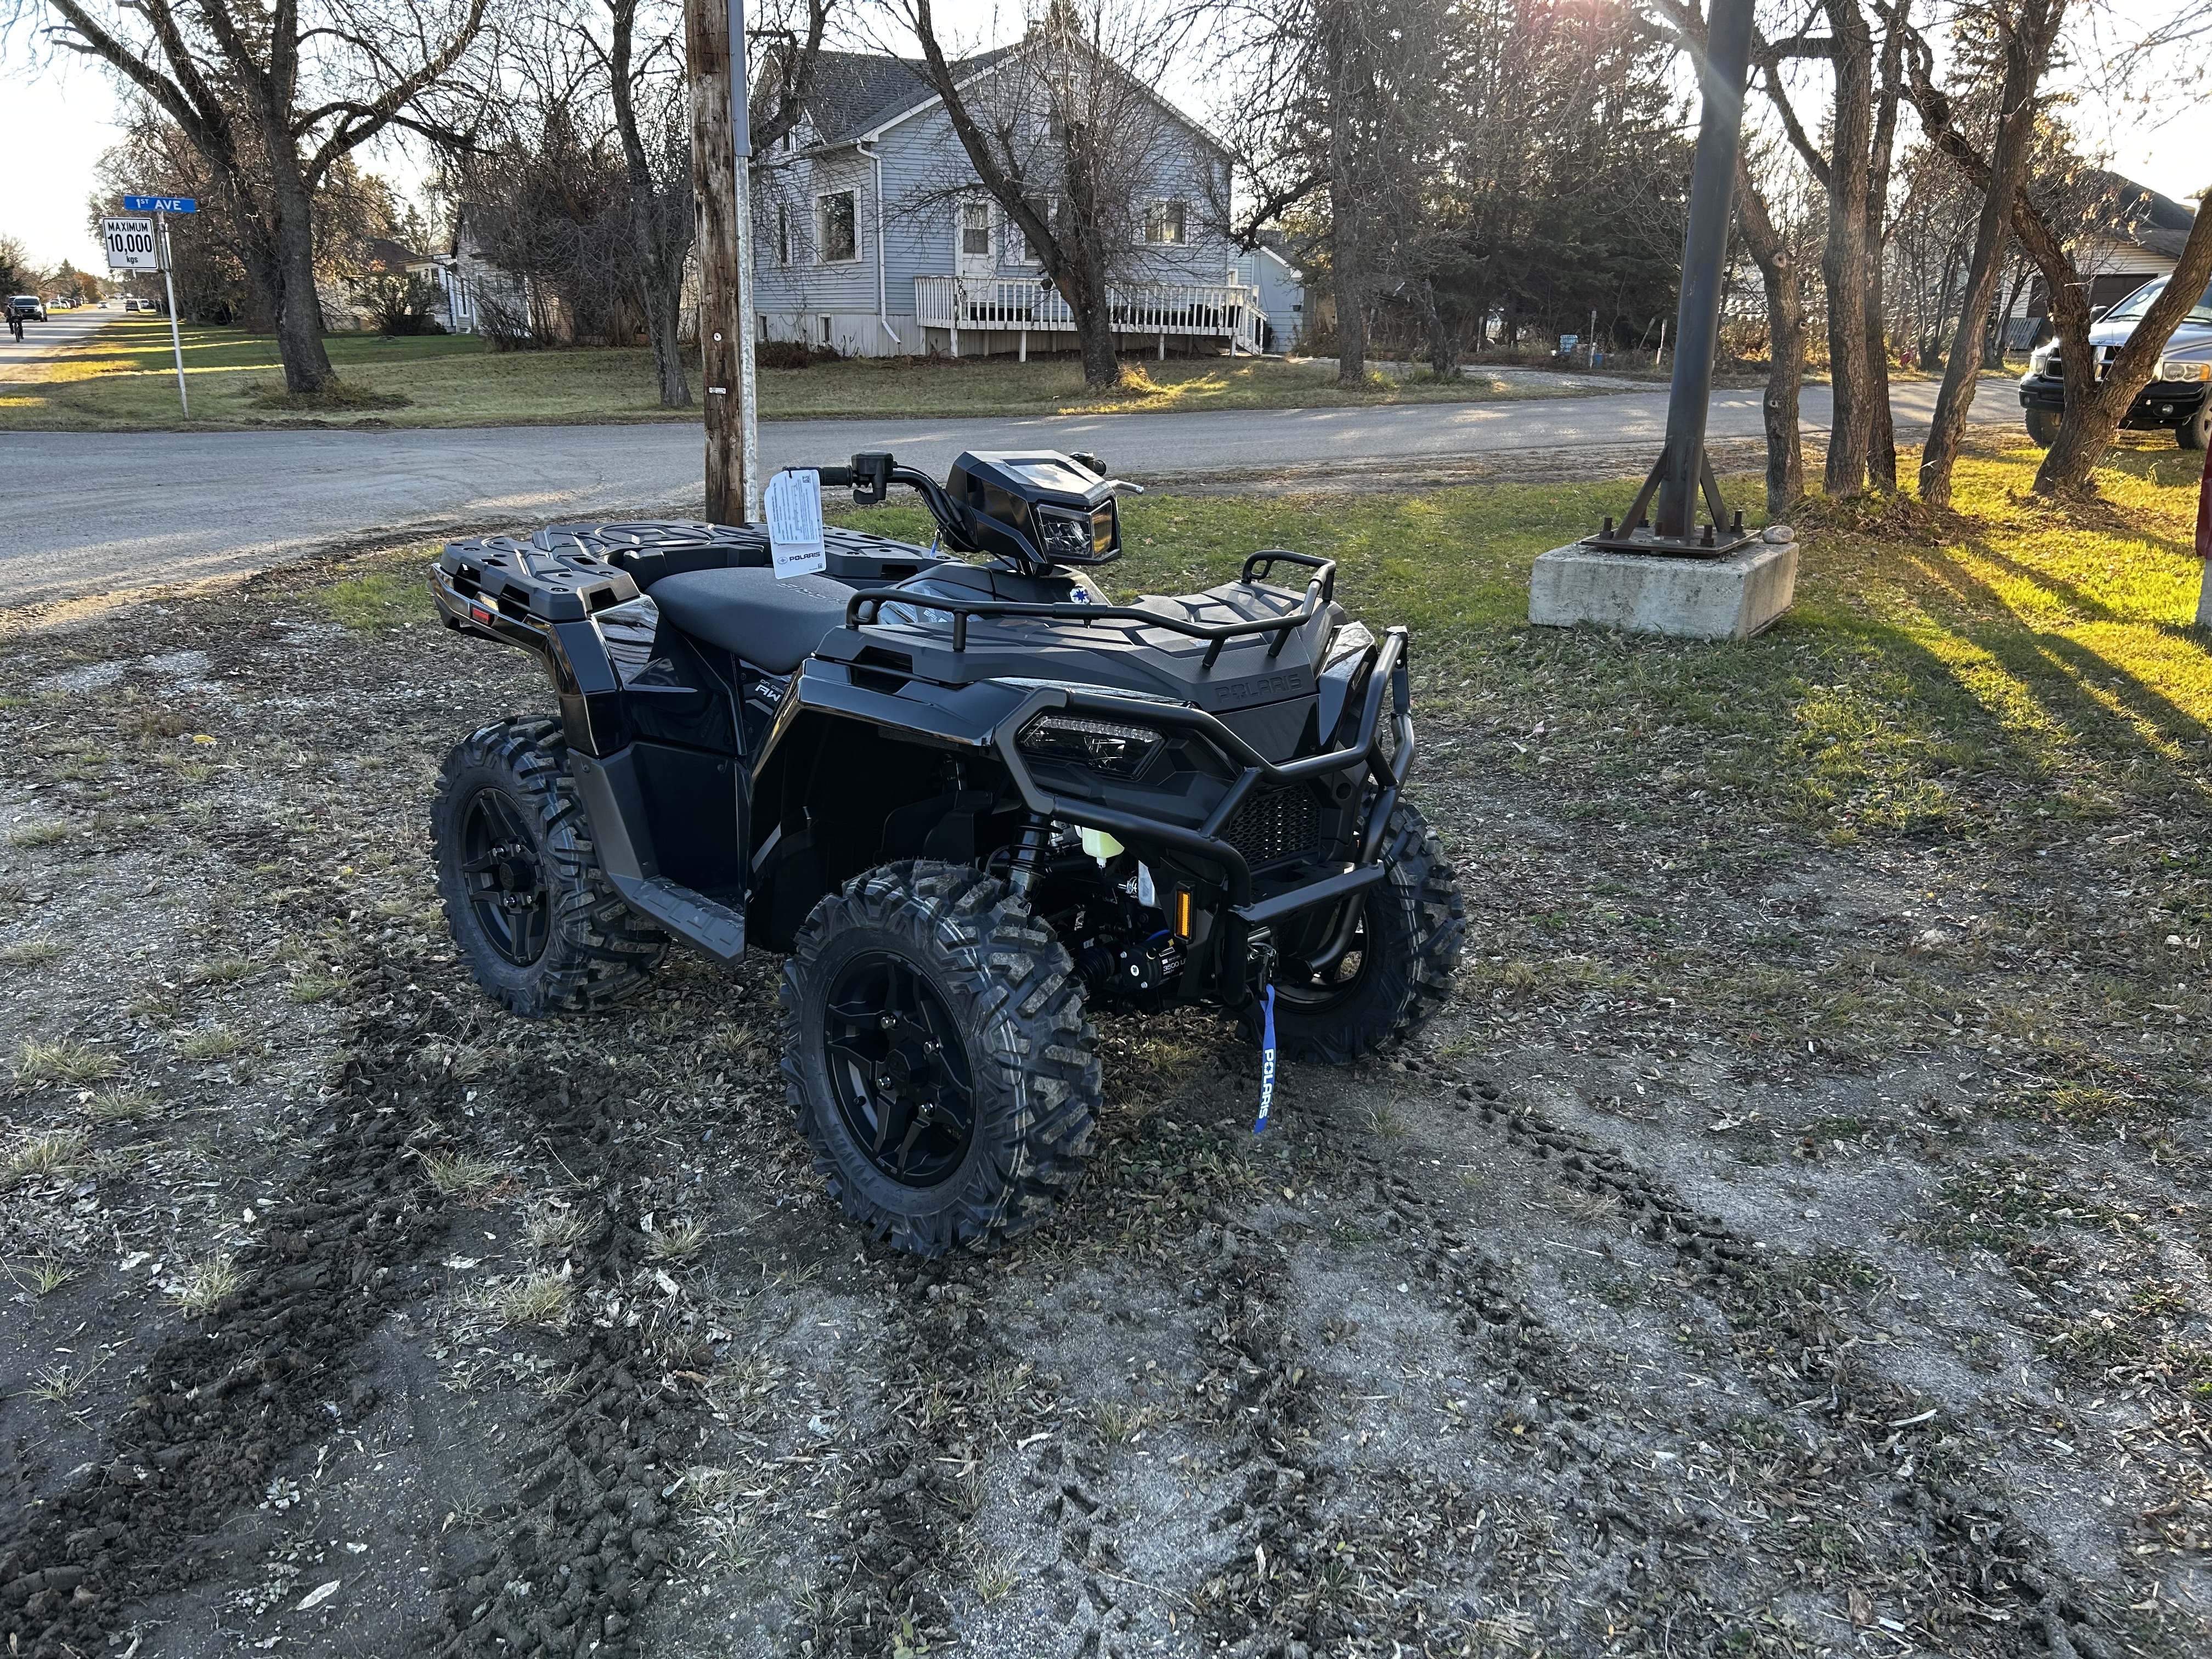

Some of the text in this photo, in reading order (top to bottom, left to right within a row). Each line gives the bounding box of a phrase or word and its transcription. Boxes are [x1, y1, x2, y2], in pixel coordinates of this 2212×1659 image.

[155, 199, 182, 211] AVE
[108, 222, 148, 232] MAXIMUM
[108, 234, 153, 255] 10,000
[126, 256, 138, 264] kgs
[789, 551, 821, 561] POLARIS
[1215, 674, 1302, 703] POLARIS
[1259, 1048, 1274, 1119] POLARIS
